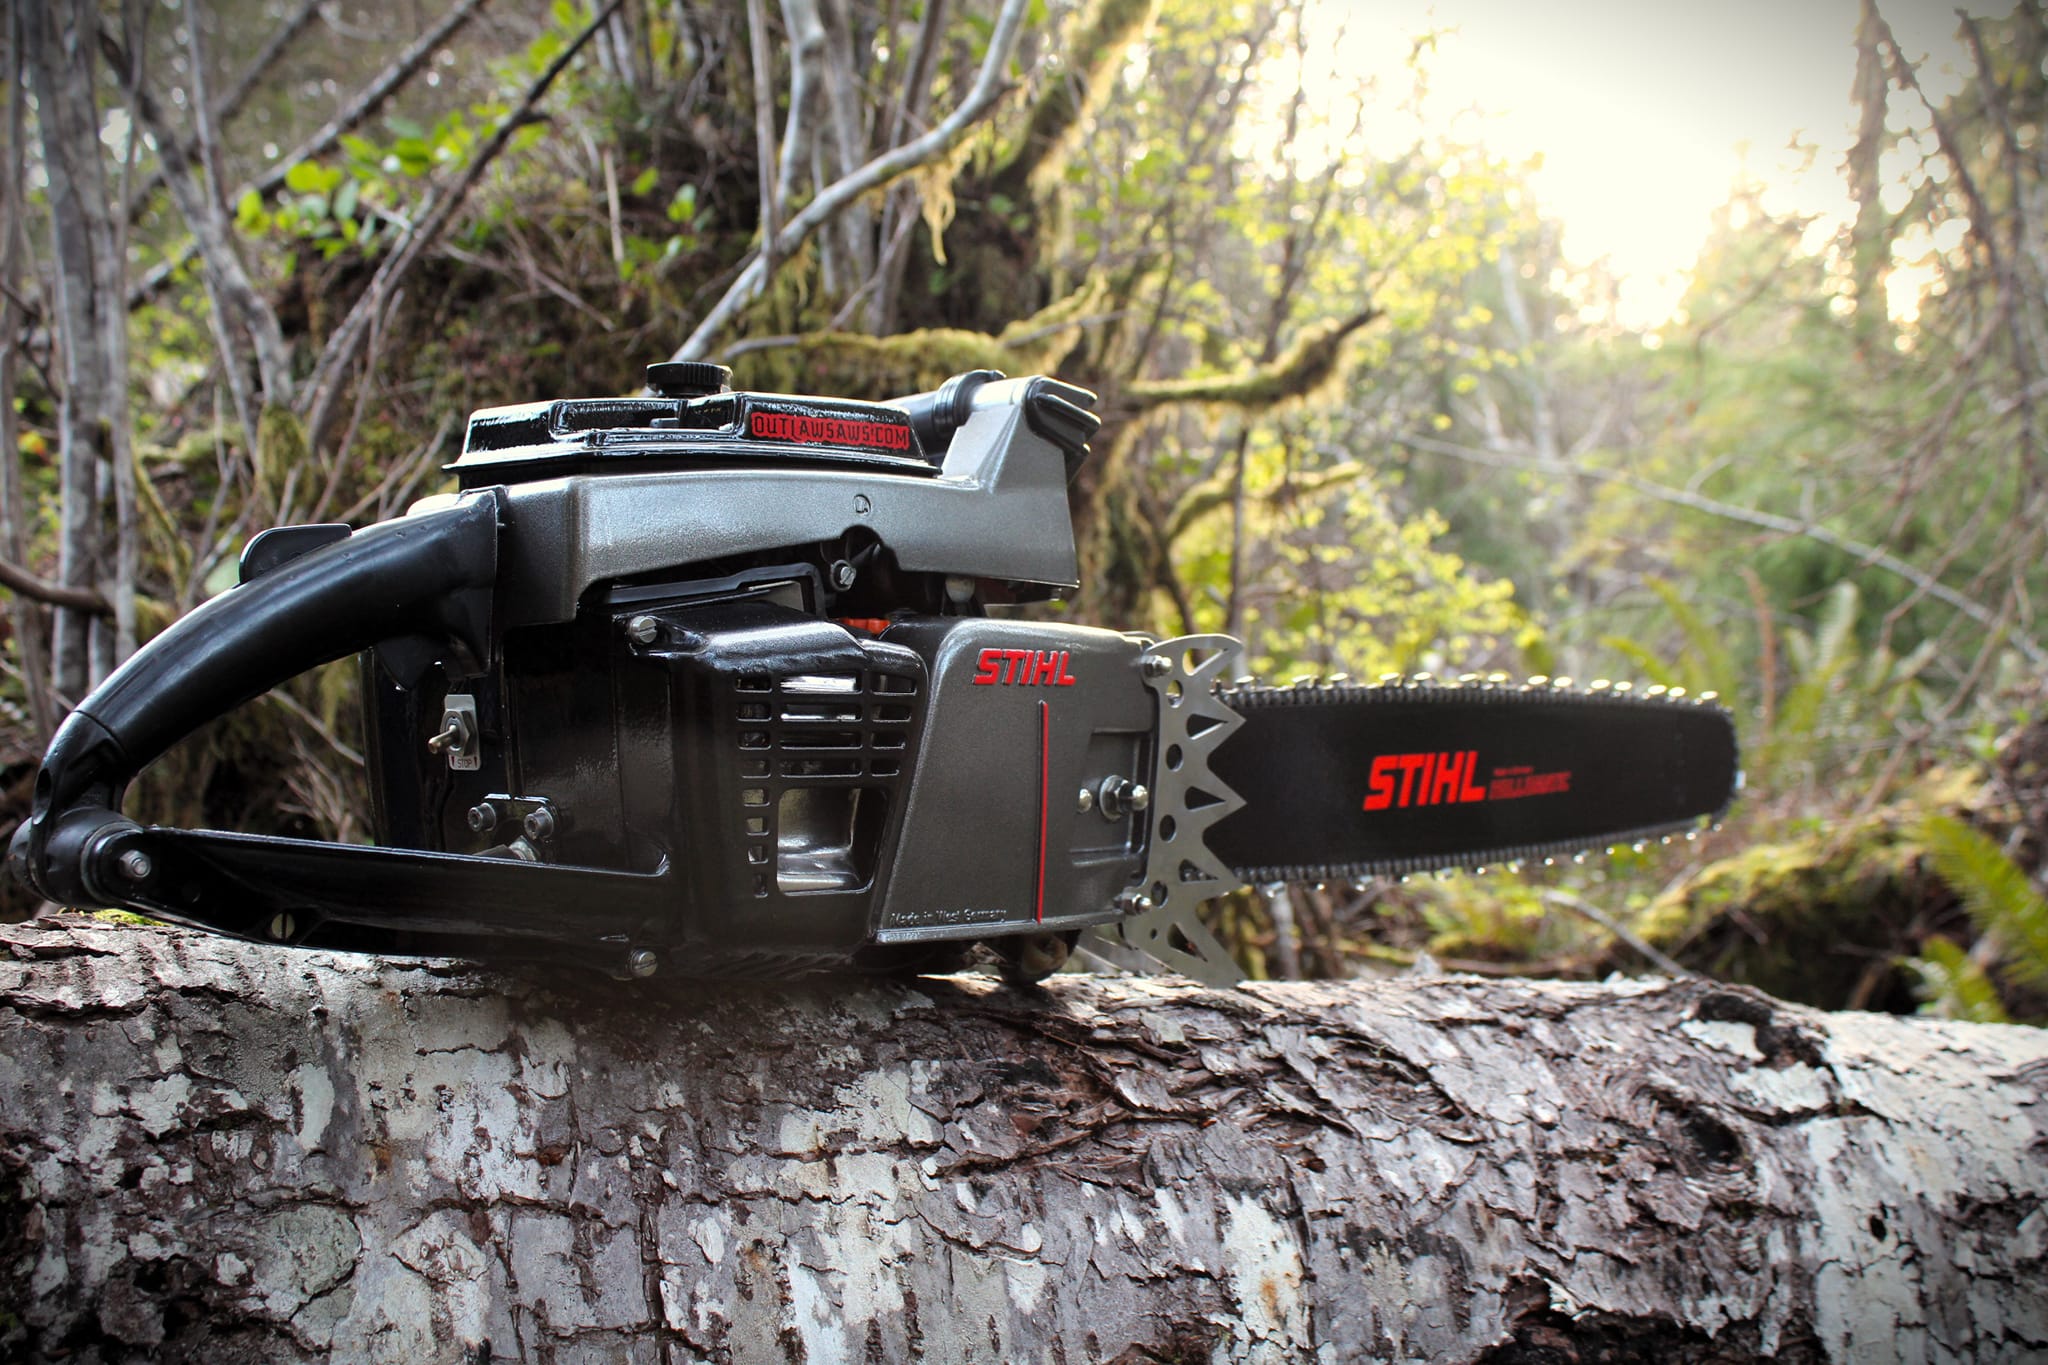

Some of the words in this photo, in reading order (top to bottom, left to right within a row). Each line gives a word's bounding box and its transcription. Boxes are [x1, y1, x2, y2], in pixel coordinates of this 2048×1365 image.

[972, 647, 1076, 686] STIHL
[457, 758, 473, 769] STOP
[1363, 751, 1486, 811] STIHL
[889, 911, 921, 926] Made
[923, 911, 933, 921] in
[935, 909, 961, 922] West
[963, 907, 1008, 923] Germany
